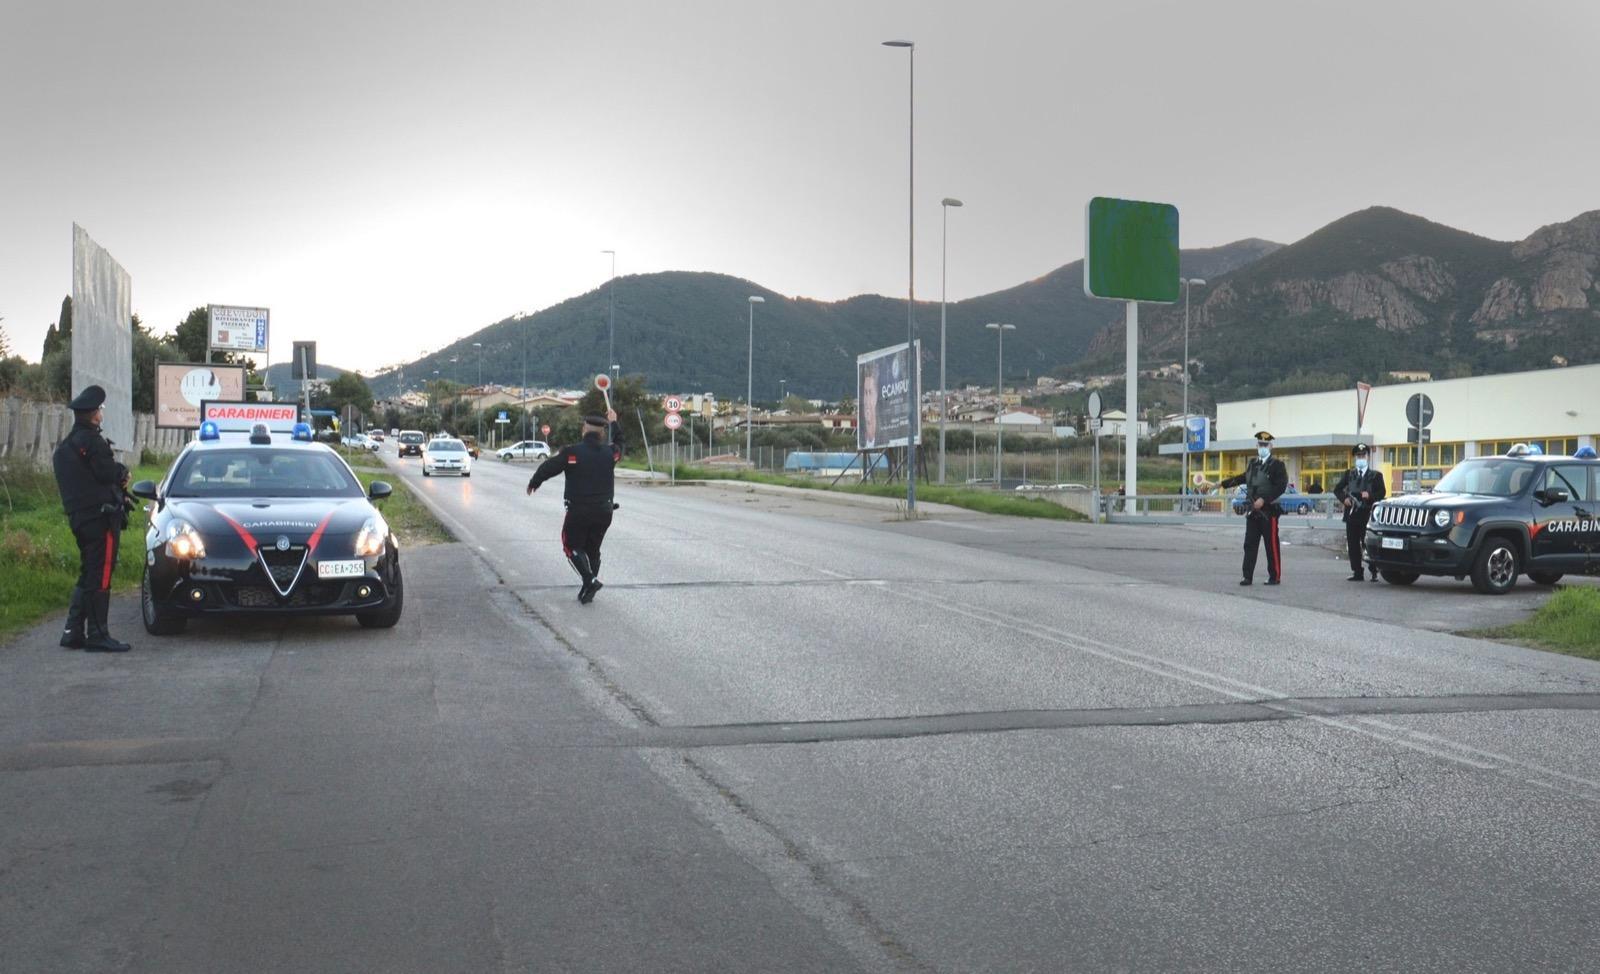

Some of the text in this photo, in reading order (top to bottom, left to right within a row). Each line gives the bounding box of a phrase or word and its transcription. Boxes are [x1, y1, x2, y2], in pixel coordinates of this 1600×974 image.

[257, 320, 265, 347] HOTEL
[207, 407, 295, 420] CARABINIERI
[243, 520, 317, 528] CARABINIERI
[1547, 520, 1600, 532] CARABIN
